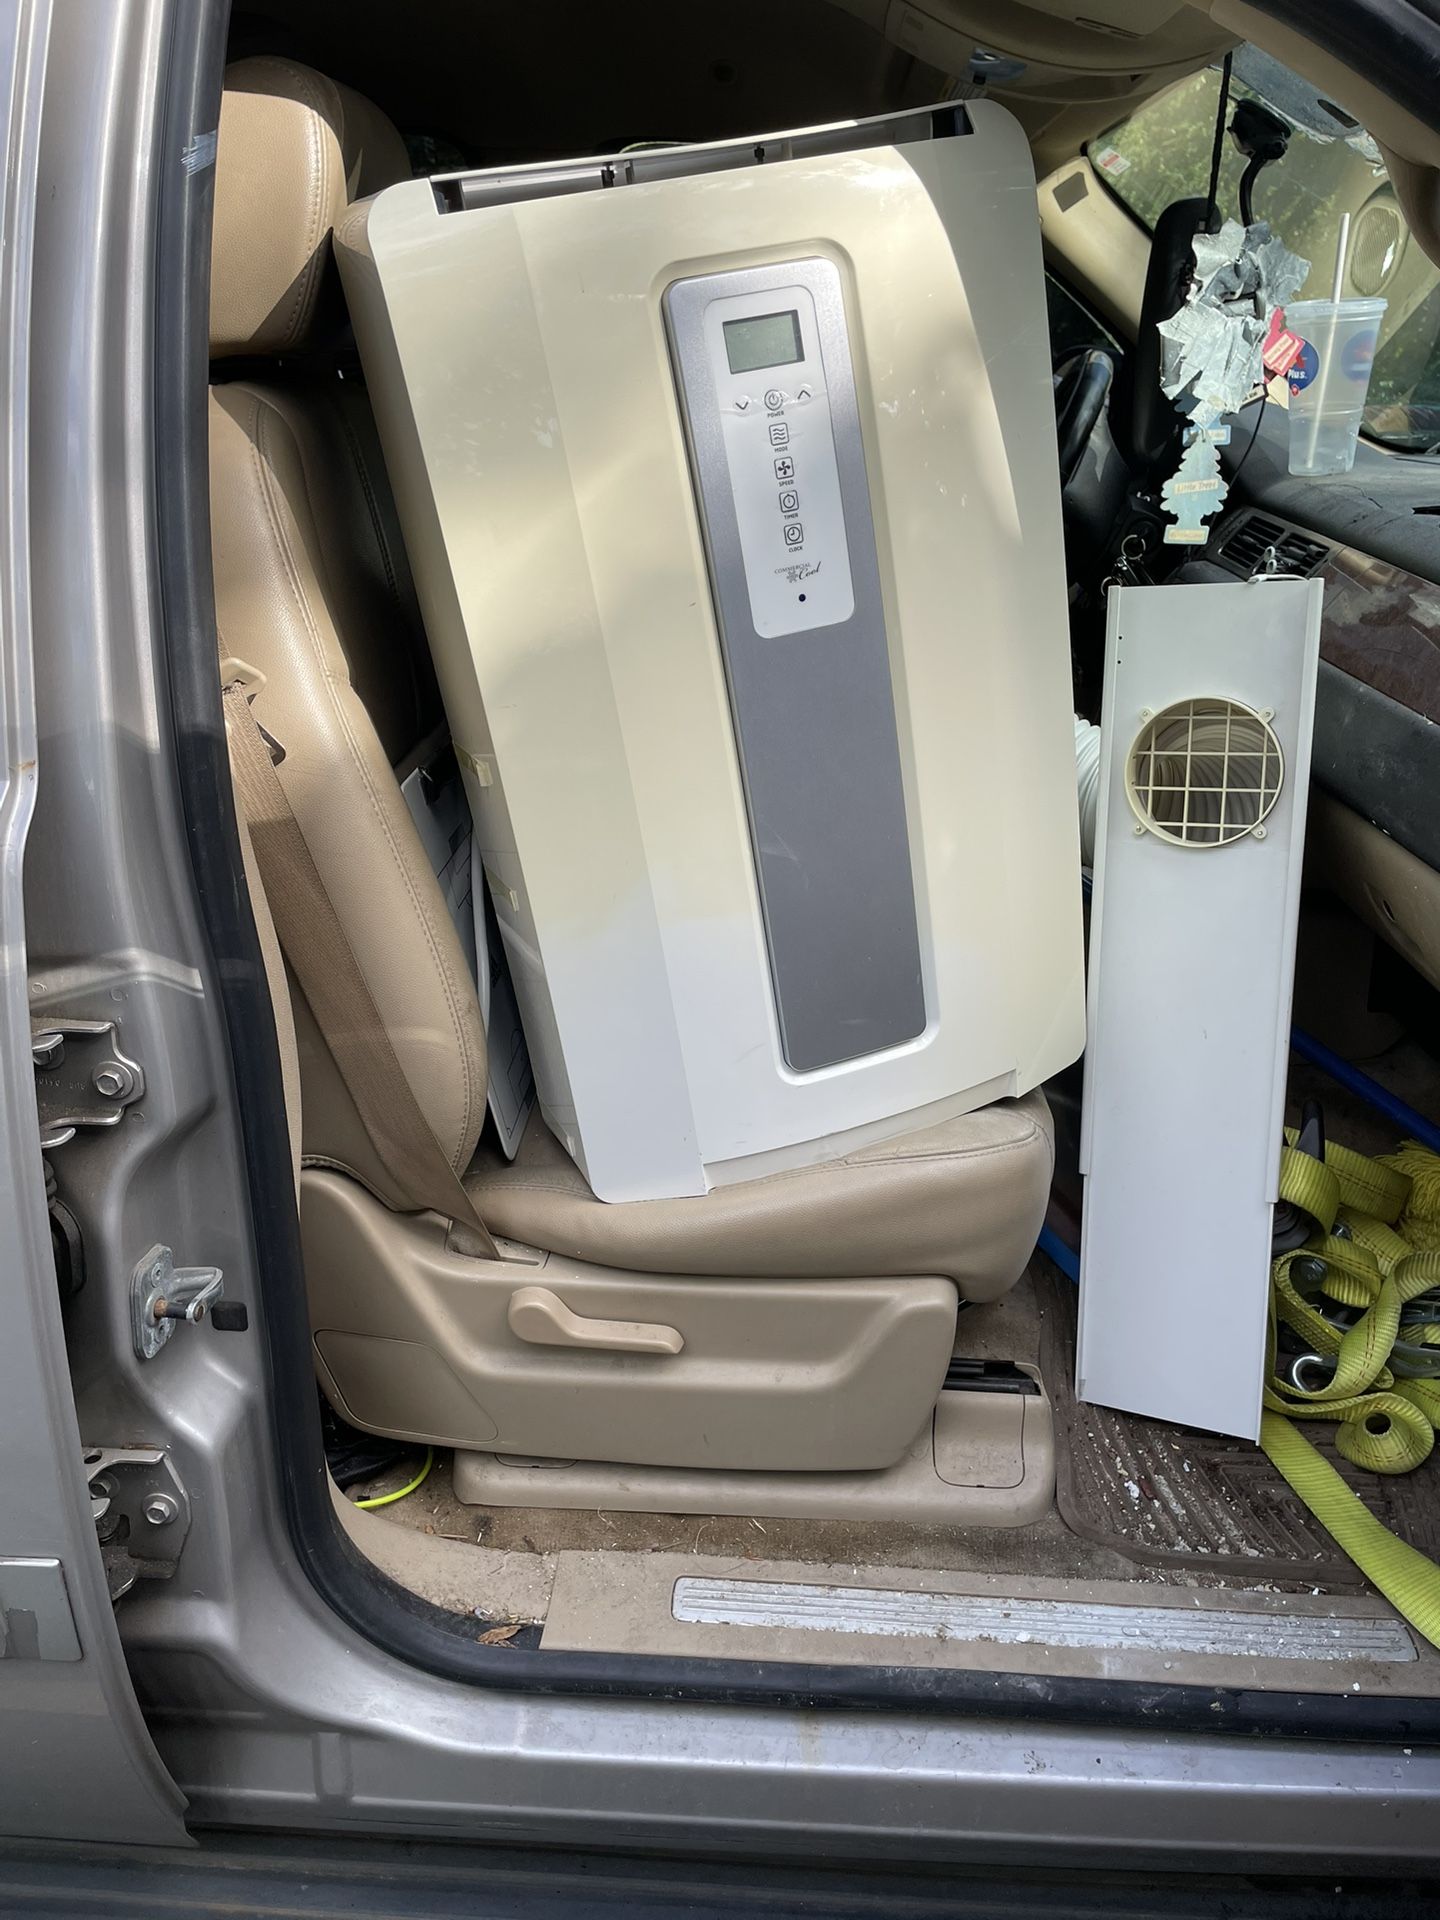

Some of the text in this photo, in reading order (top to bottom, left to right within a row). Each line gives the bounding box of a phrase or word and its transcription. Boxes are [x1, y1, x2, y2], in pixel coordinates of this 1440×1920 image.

[767, 410, 784, 418] POWER
[774, 562, 811, 574] COMMERCIAL
[798, 561, 821, 580] Cool
